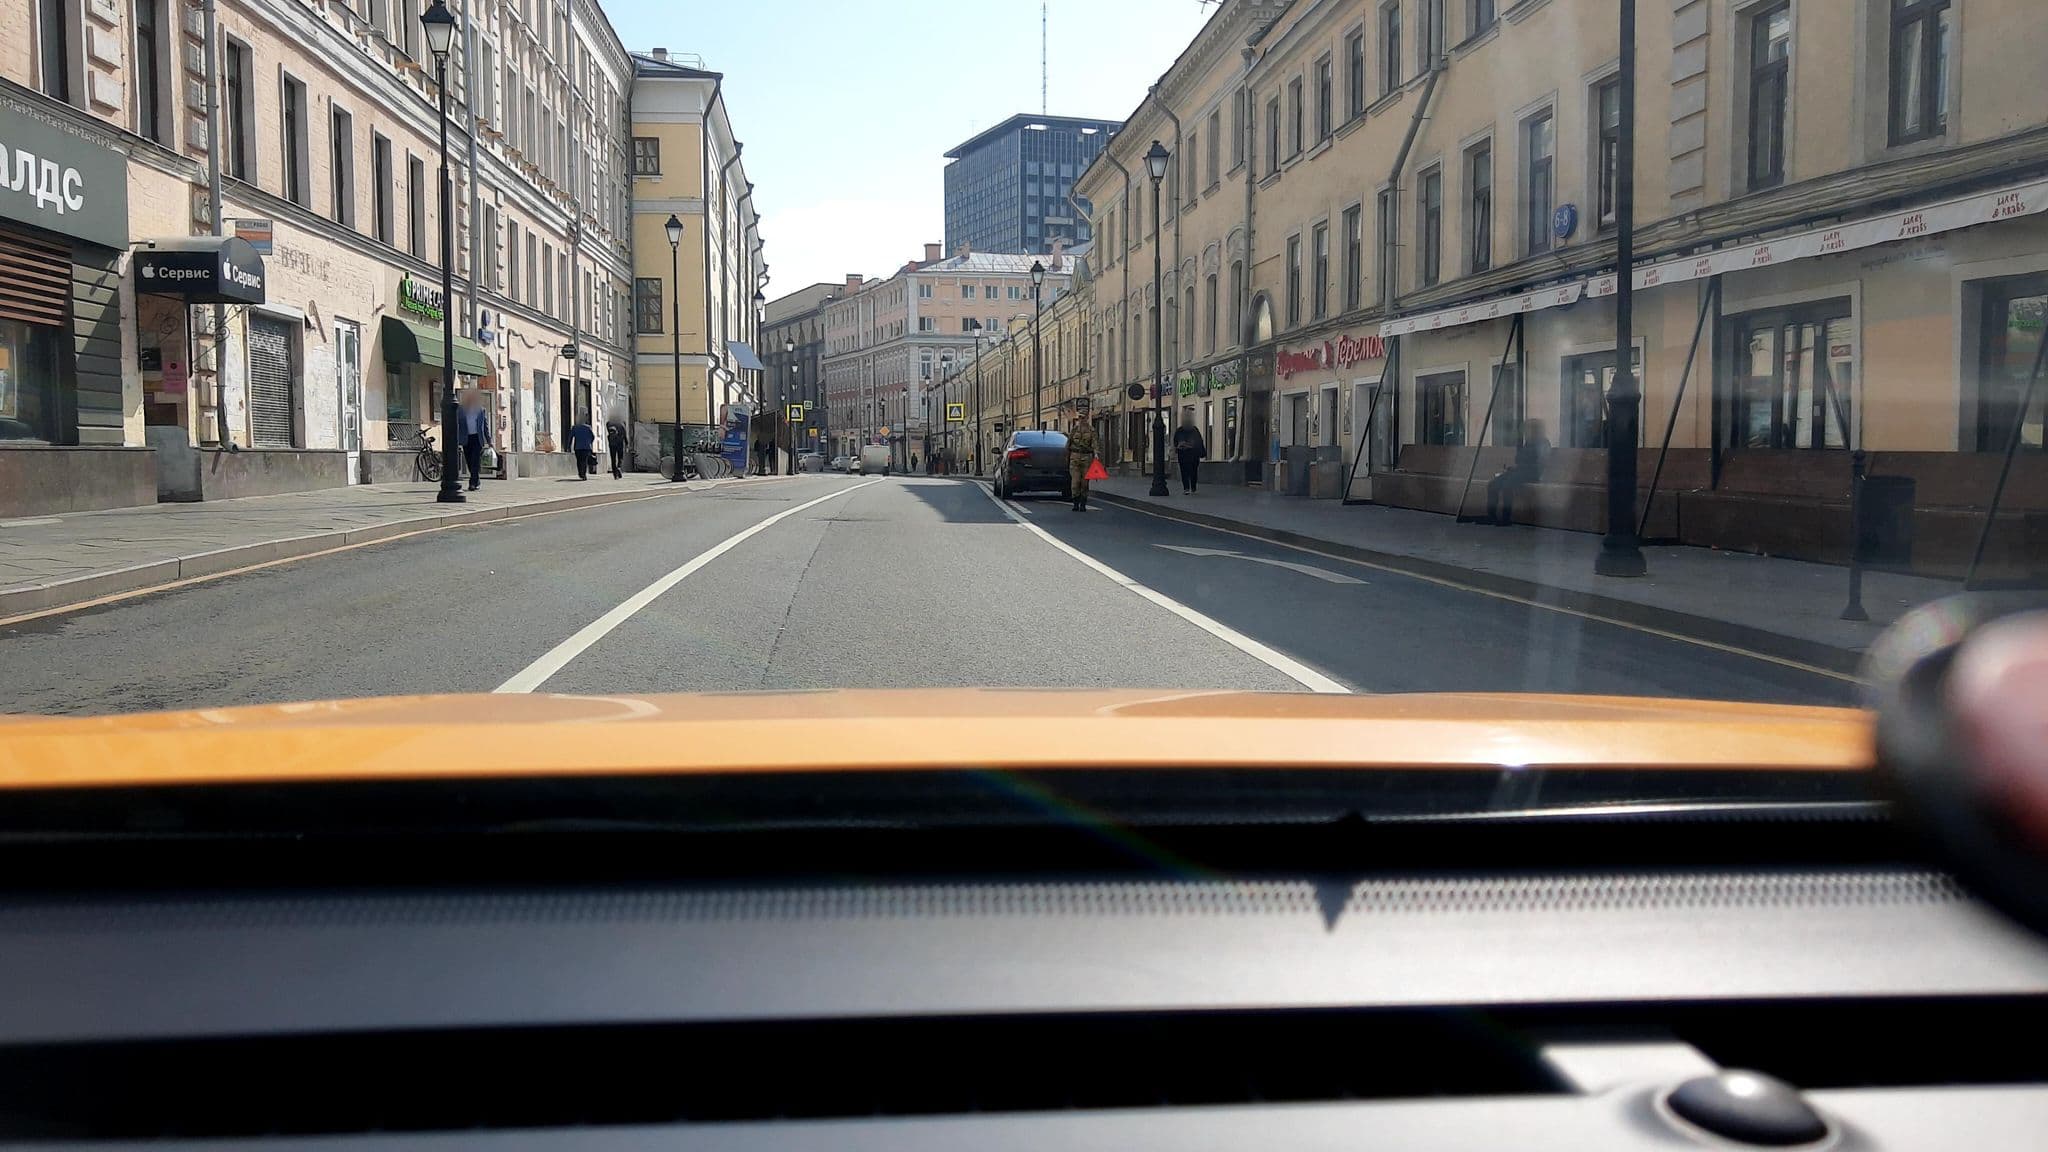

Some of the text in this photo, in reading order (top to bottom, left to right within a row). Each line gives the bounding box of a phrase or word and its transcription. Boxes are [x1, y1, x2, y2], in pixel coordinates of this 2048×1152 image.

[159, 267, 210, 281] Сервис
[232, 265, 261, 289] Сервис
[1336, 336, 1386, 369] Теремок
